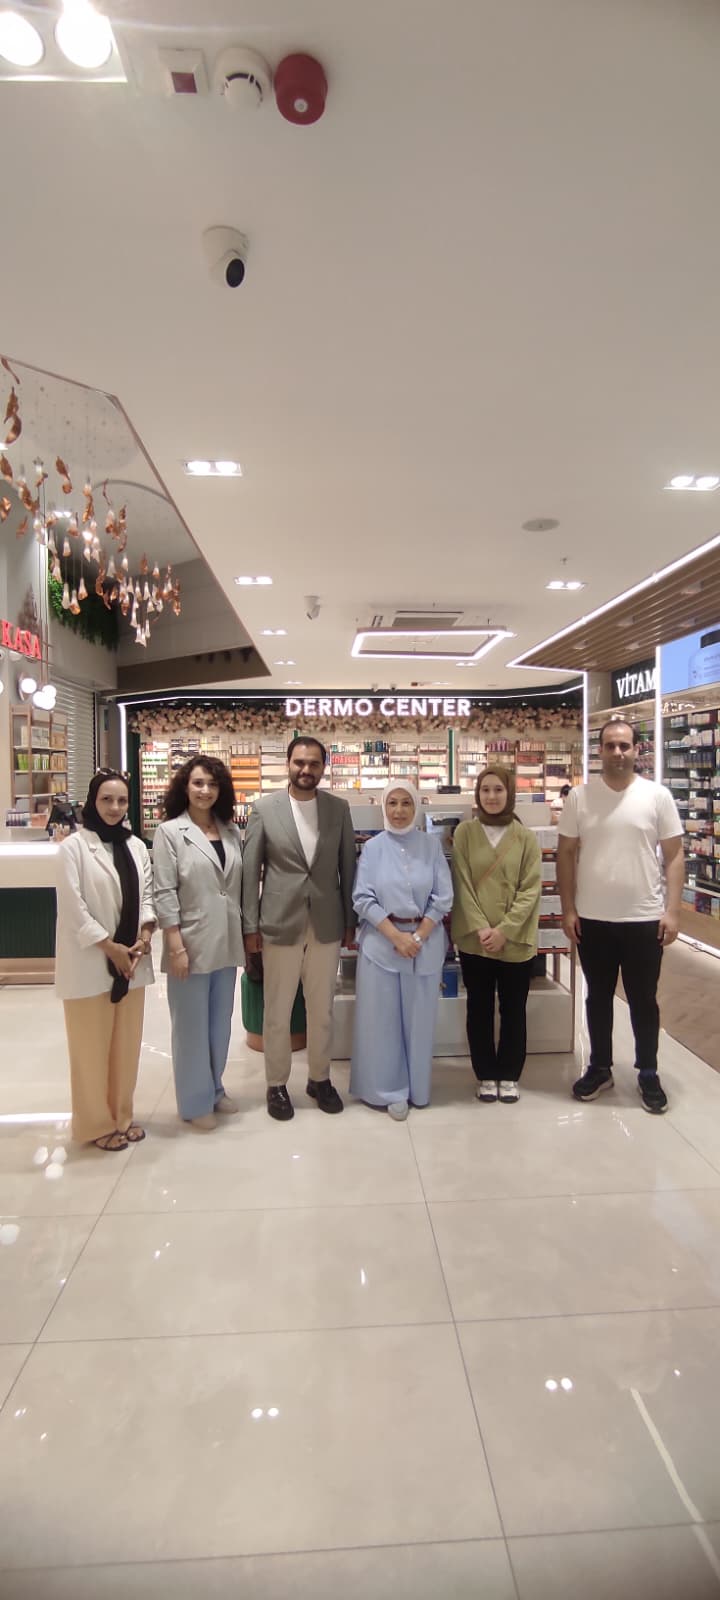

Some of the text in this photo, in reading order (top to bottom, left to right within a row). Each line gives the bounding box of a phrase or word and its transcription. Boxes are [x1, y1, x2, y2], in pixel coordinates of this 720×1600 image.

[1, 618, 42, 660] KASA
[285, 698, 471, 717] DERMO CENTER
